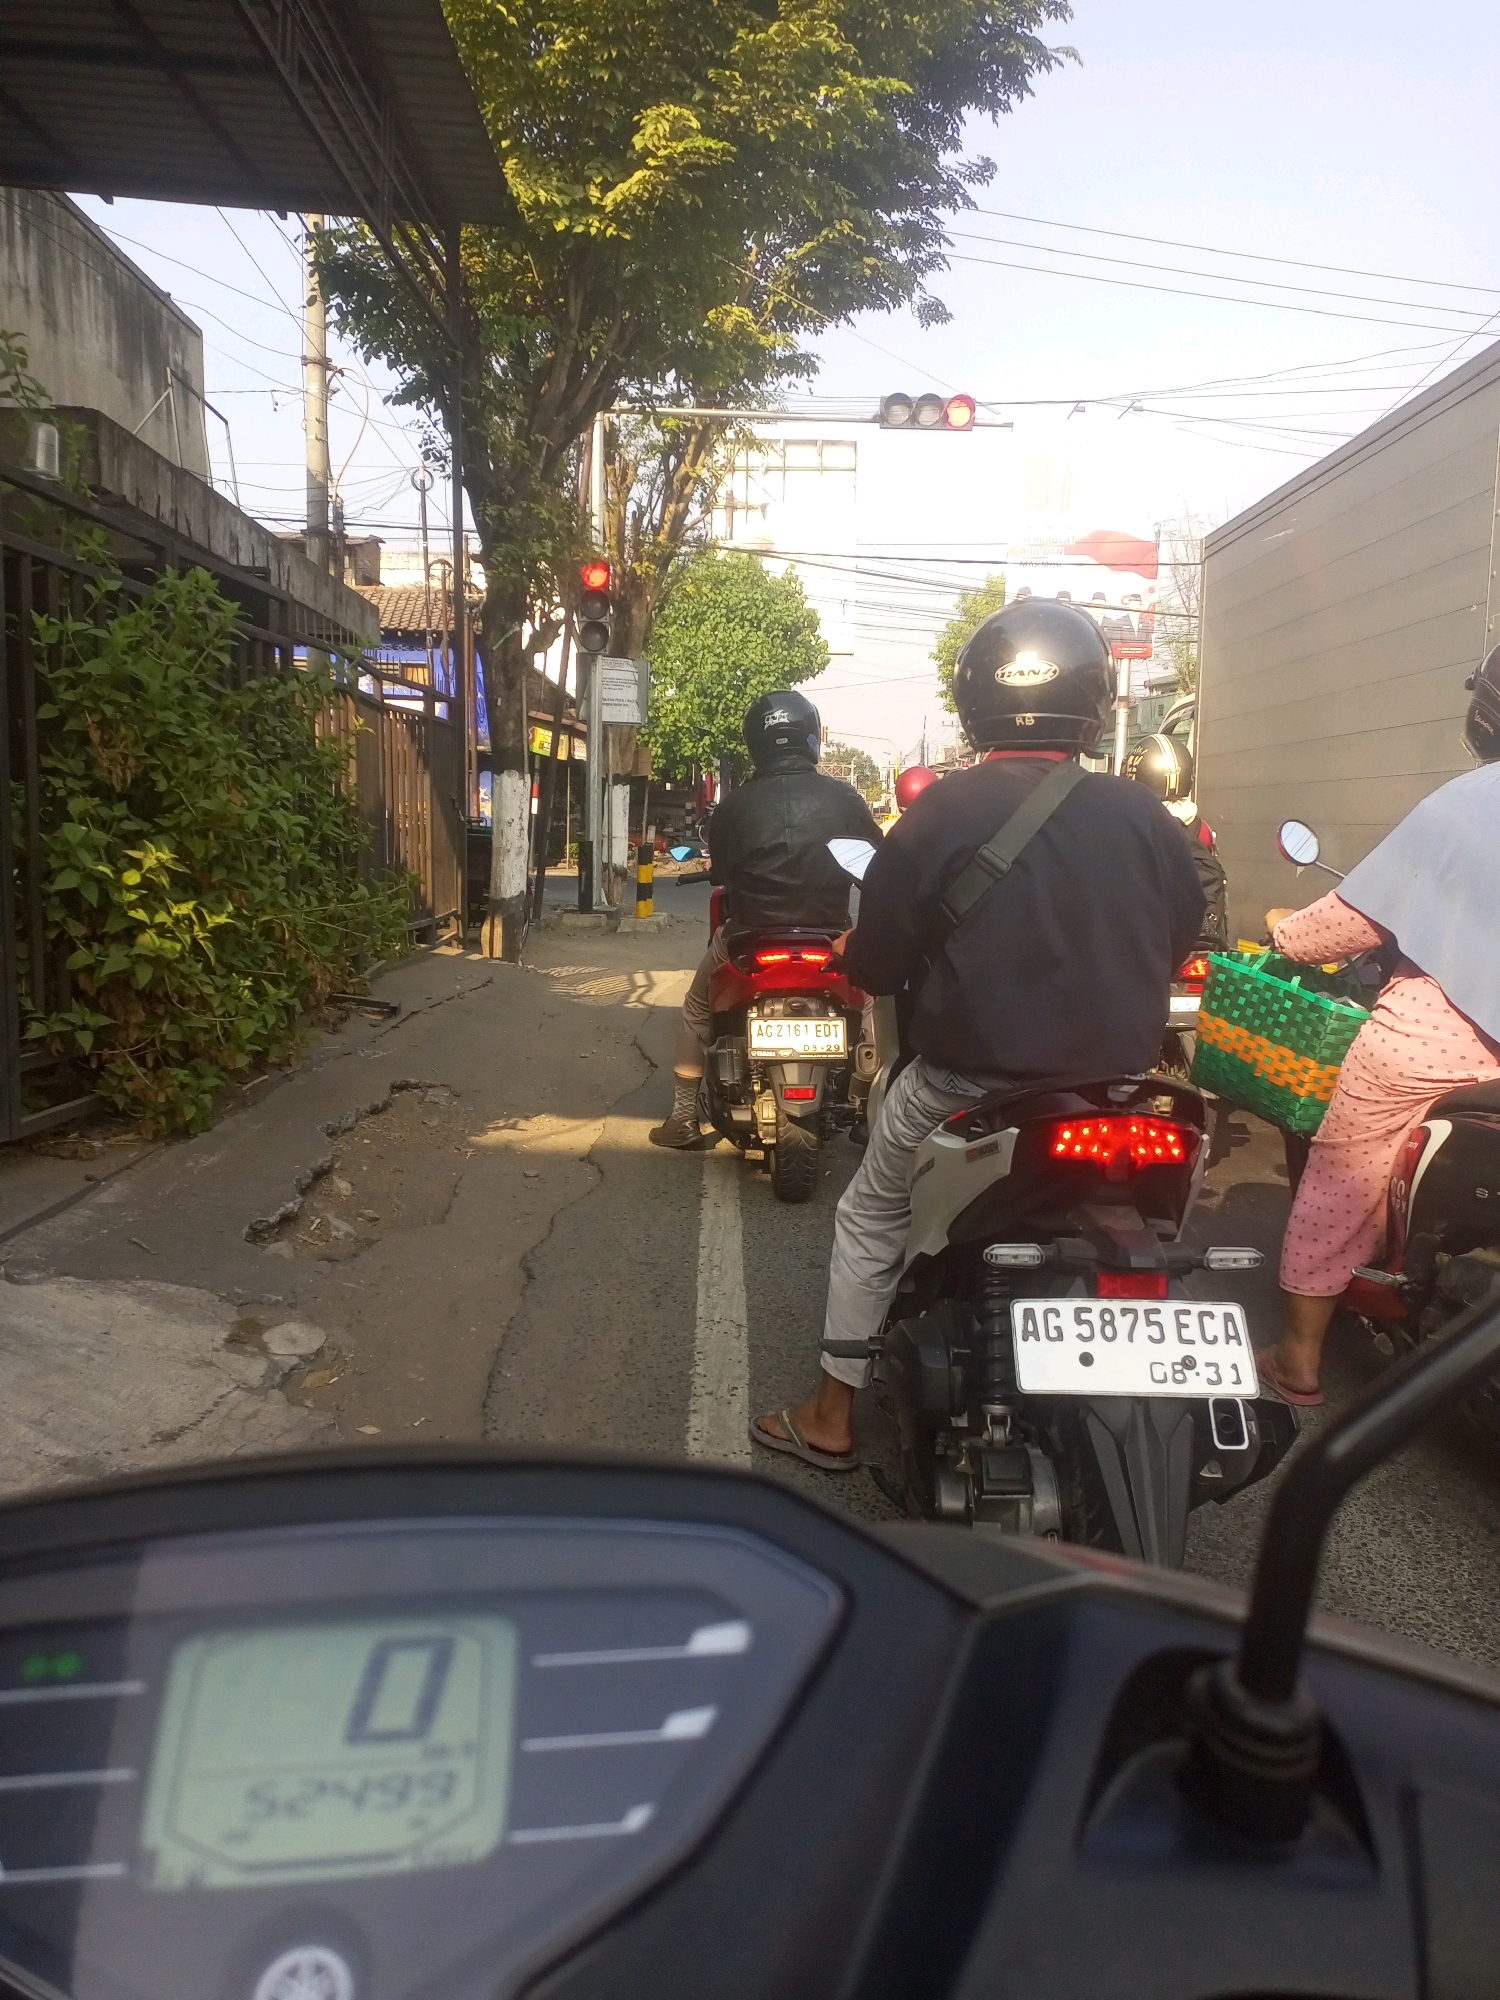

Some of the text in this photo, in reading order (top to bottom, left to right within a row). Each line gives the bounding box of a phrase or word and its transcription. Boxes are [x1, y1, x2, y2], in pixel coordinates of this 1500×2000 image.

[1015, 715, 1035, 726] RB
[757, 1024, 839, 1038] AG 2161 EDT
[1021, 1306, 1242, 1347] AG 5875 ECA
